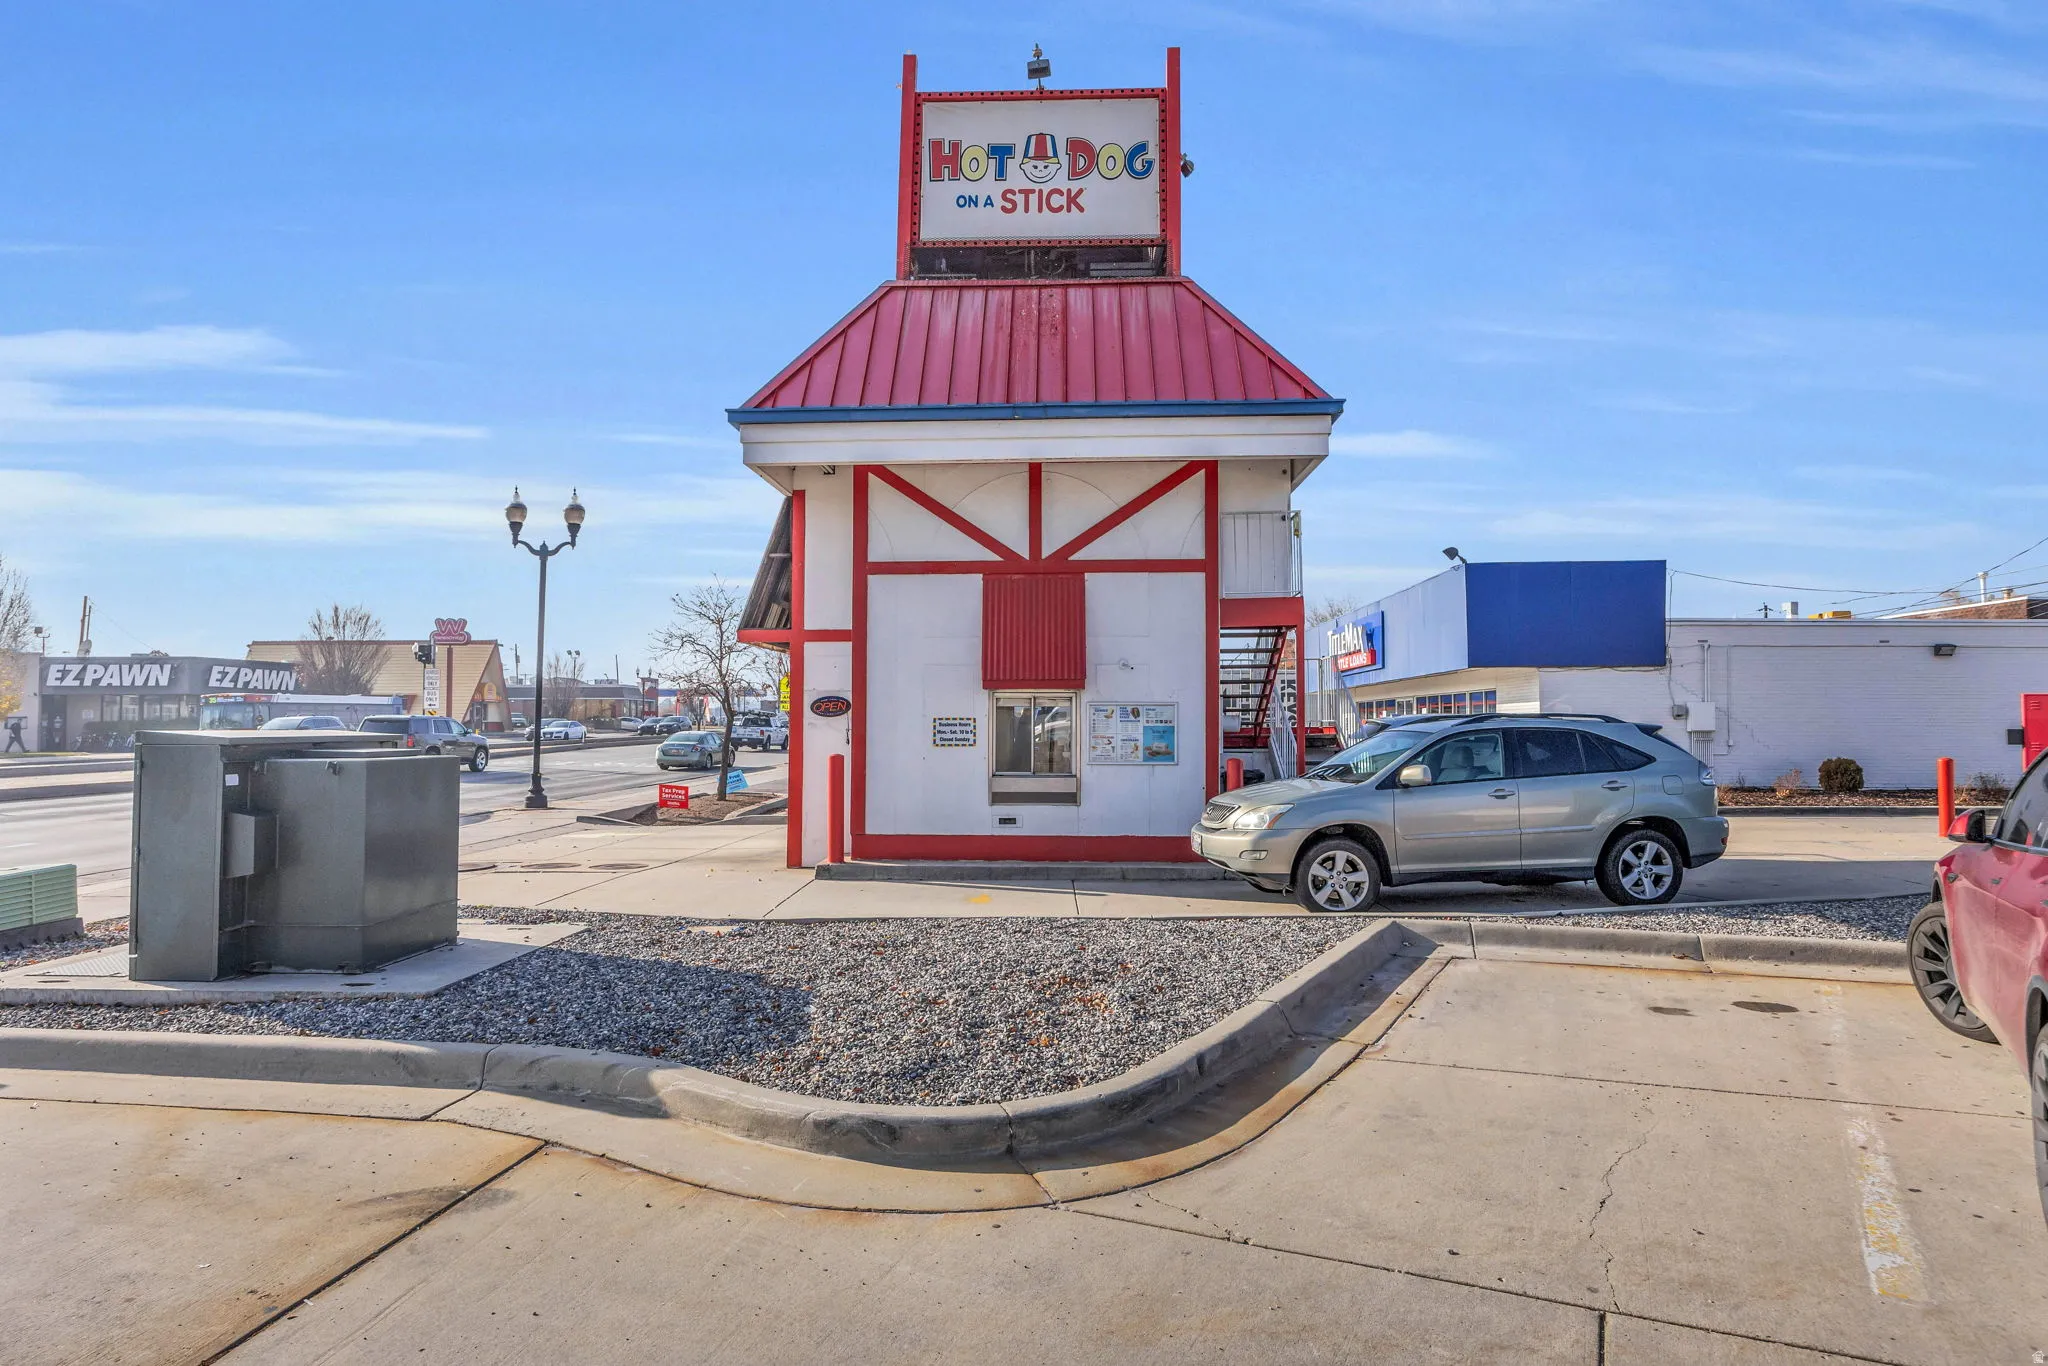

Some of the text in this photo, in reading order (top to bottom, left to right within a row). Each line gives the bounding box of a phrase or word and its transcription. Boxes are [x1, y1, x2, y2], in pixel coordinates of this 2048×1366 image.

[928, 137, 1155, 182] HOT DOG
[956, 187, 1085, 214] ON A STICK
[46, 664, 172, 687] EZPAWN
[208, 665, 297, 691] EZPAWN
[814, 701, 847, 712] OPEN
